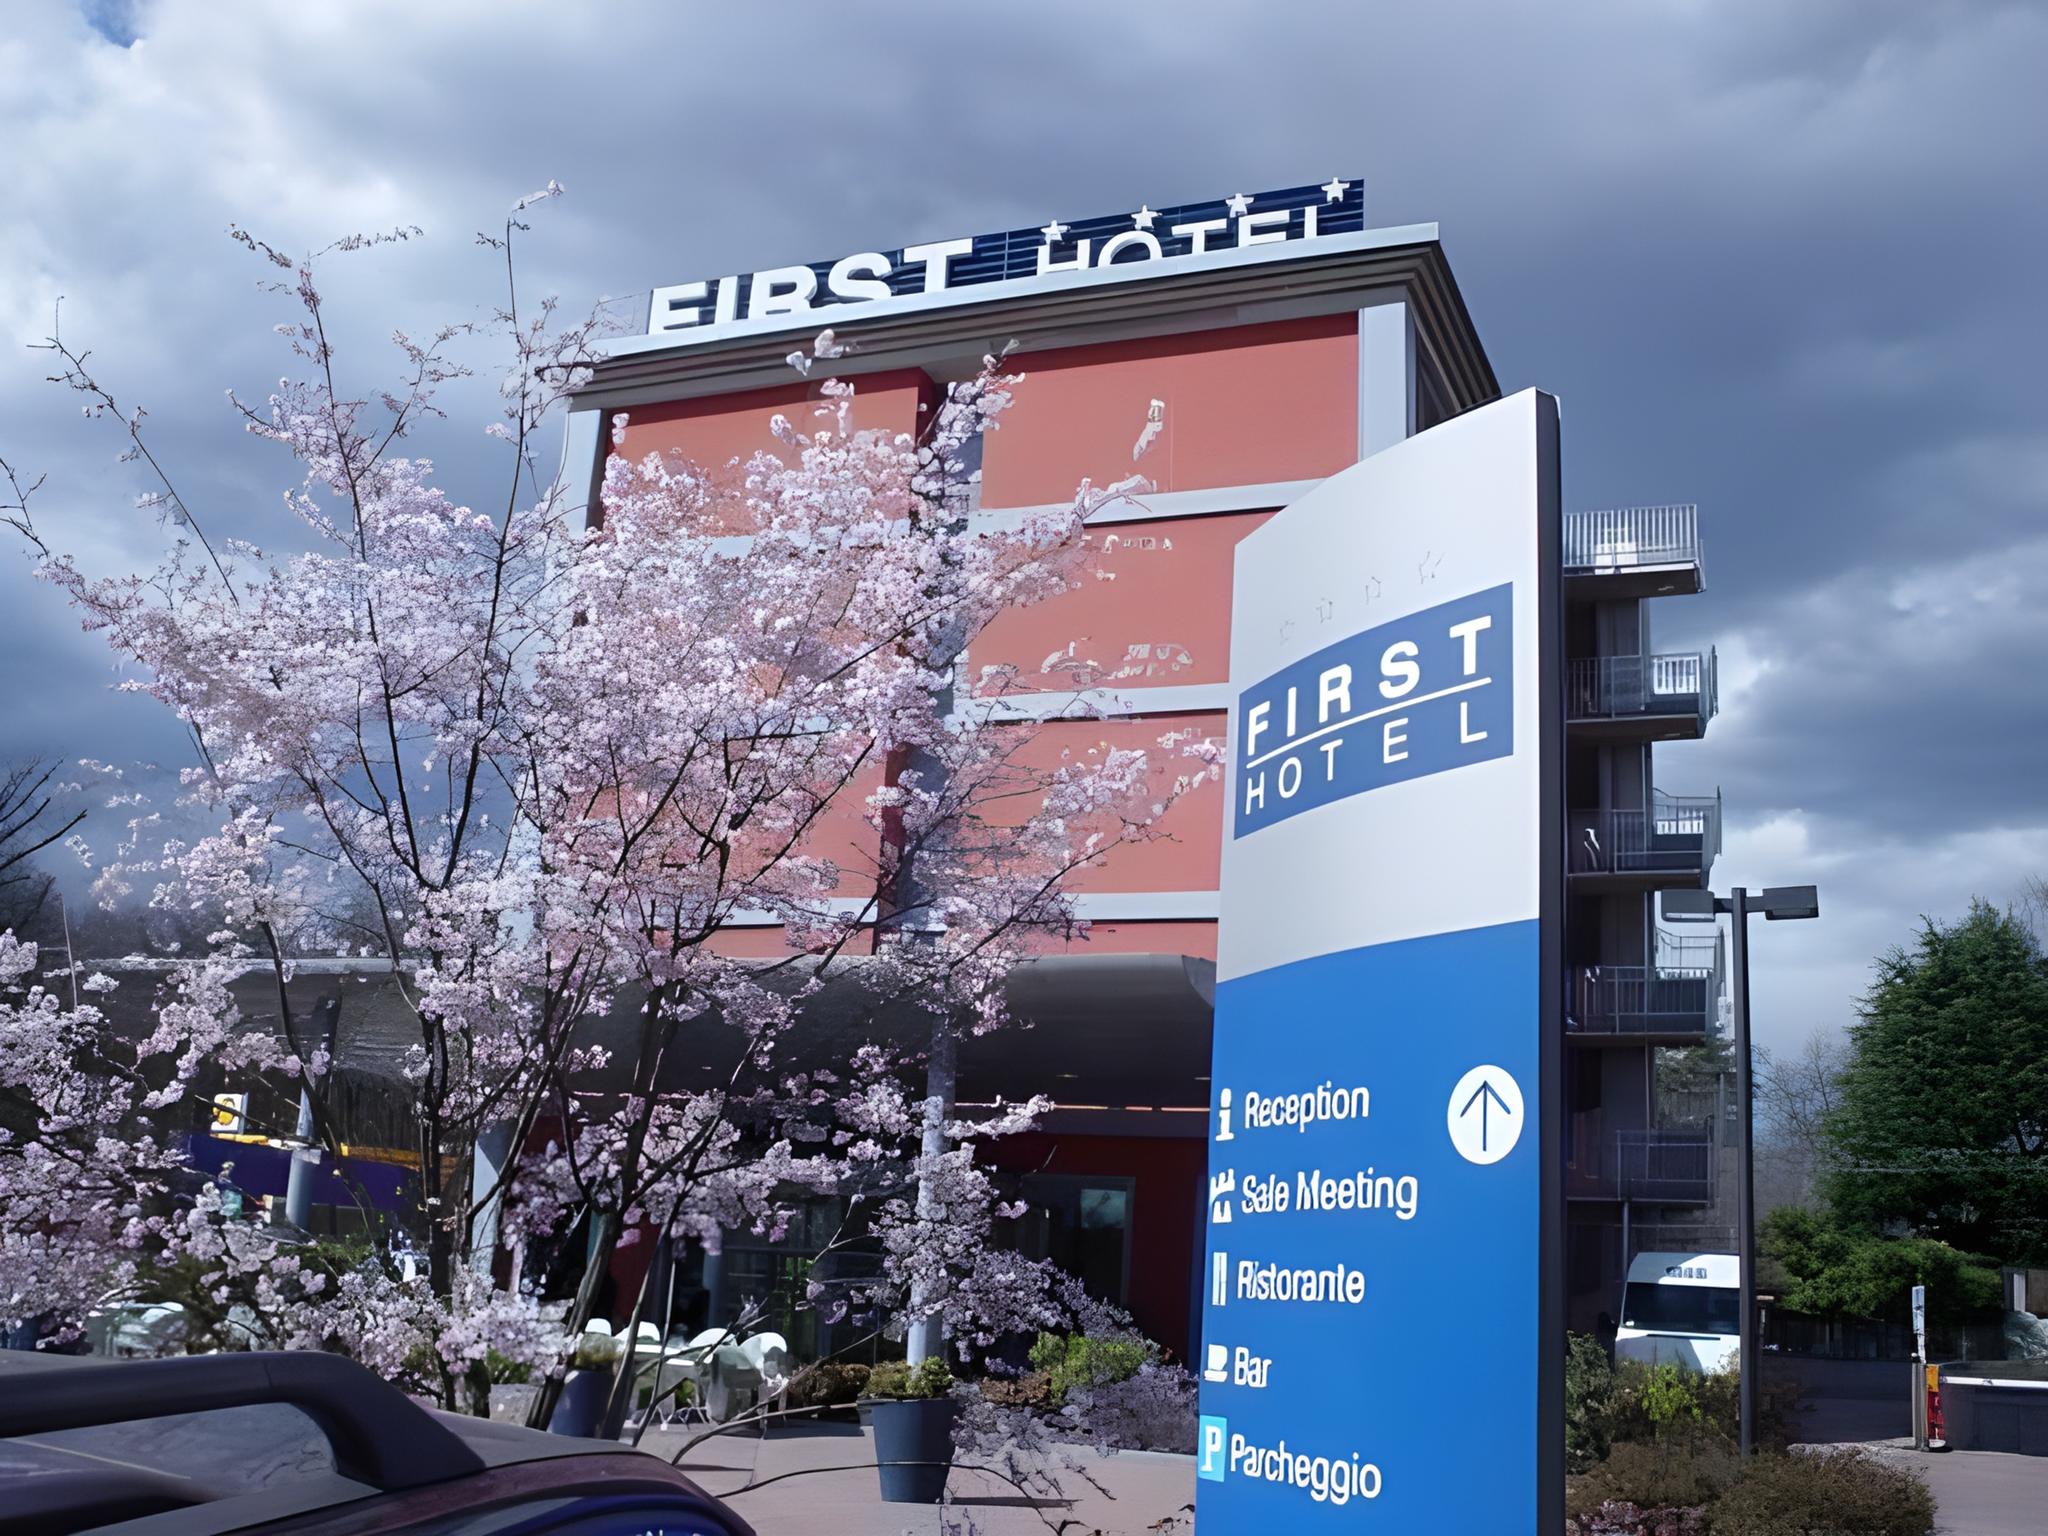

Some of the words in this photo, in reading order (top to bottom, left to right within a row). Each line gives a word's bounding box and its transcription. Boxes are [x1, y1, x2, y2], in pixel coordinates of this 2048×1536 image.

[648, 237, 974, 335] FIRST
[1247, 615, 1492, 757] FIRST
[1245, 701, 1489, 816] HOTEL
[1244, 1080, 1370, 1133] Reception
[1241, 1173, 1290, 1214] Sale
[1295, 1167, 1418, 1220] Meeting
[1237, 1260, 1365, 1304] Ristorante
[1234, 1346, 1272, 1388] Bar
[1201, 1424, 1222, 1472] P
[1230, 1433, 1382, 1505] Parcheggio
